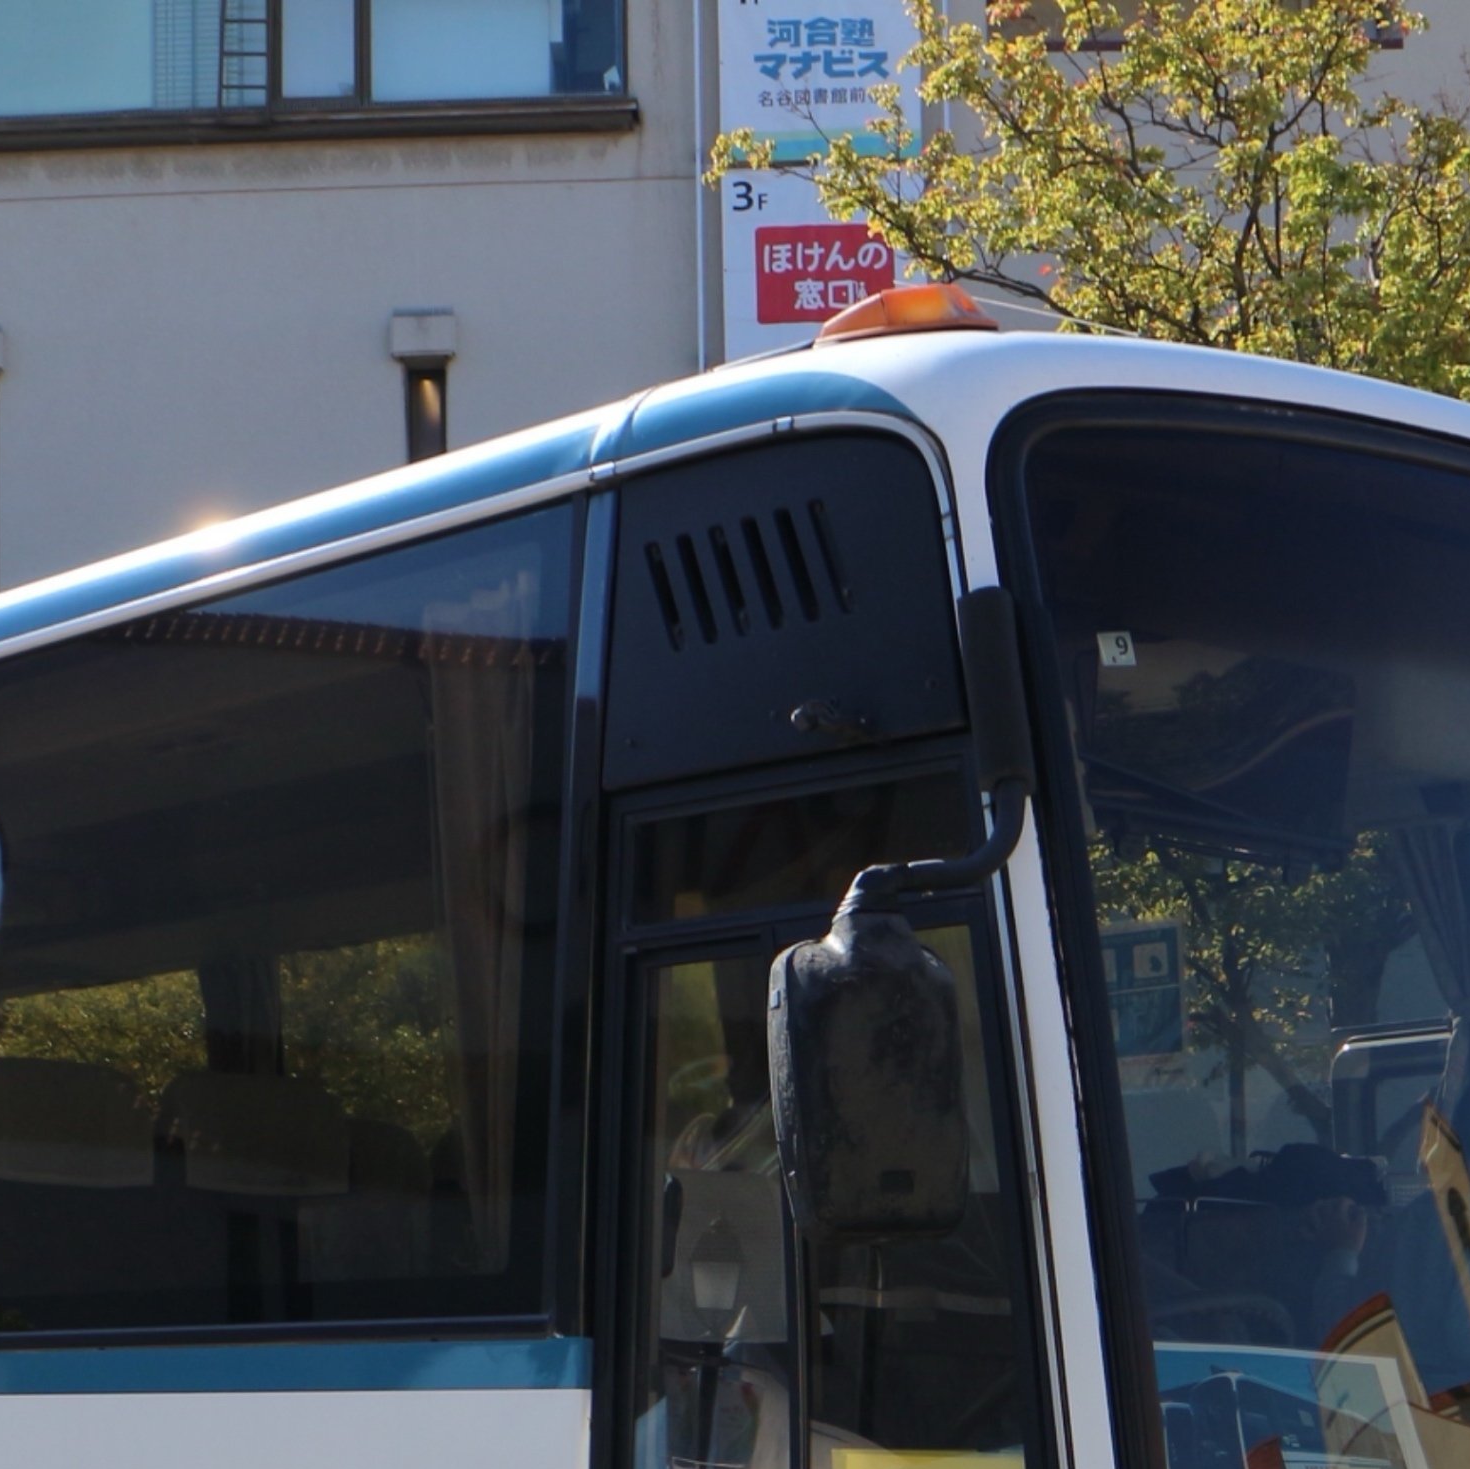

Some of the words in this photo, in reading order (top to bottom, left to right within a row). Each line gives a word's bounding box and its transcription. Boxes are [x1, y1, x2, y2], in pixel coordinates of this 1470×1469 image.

[767, 17, 875, 48] 河合塾
[753, 50, 890, 80] マナビス
[732, 181, 768, 211] 3F
[763, 242, 888, 273] ほけんの
[794, 279, 854, 310] 窓口
